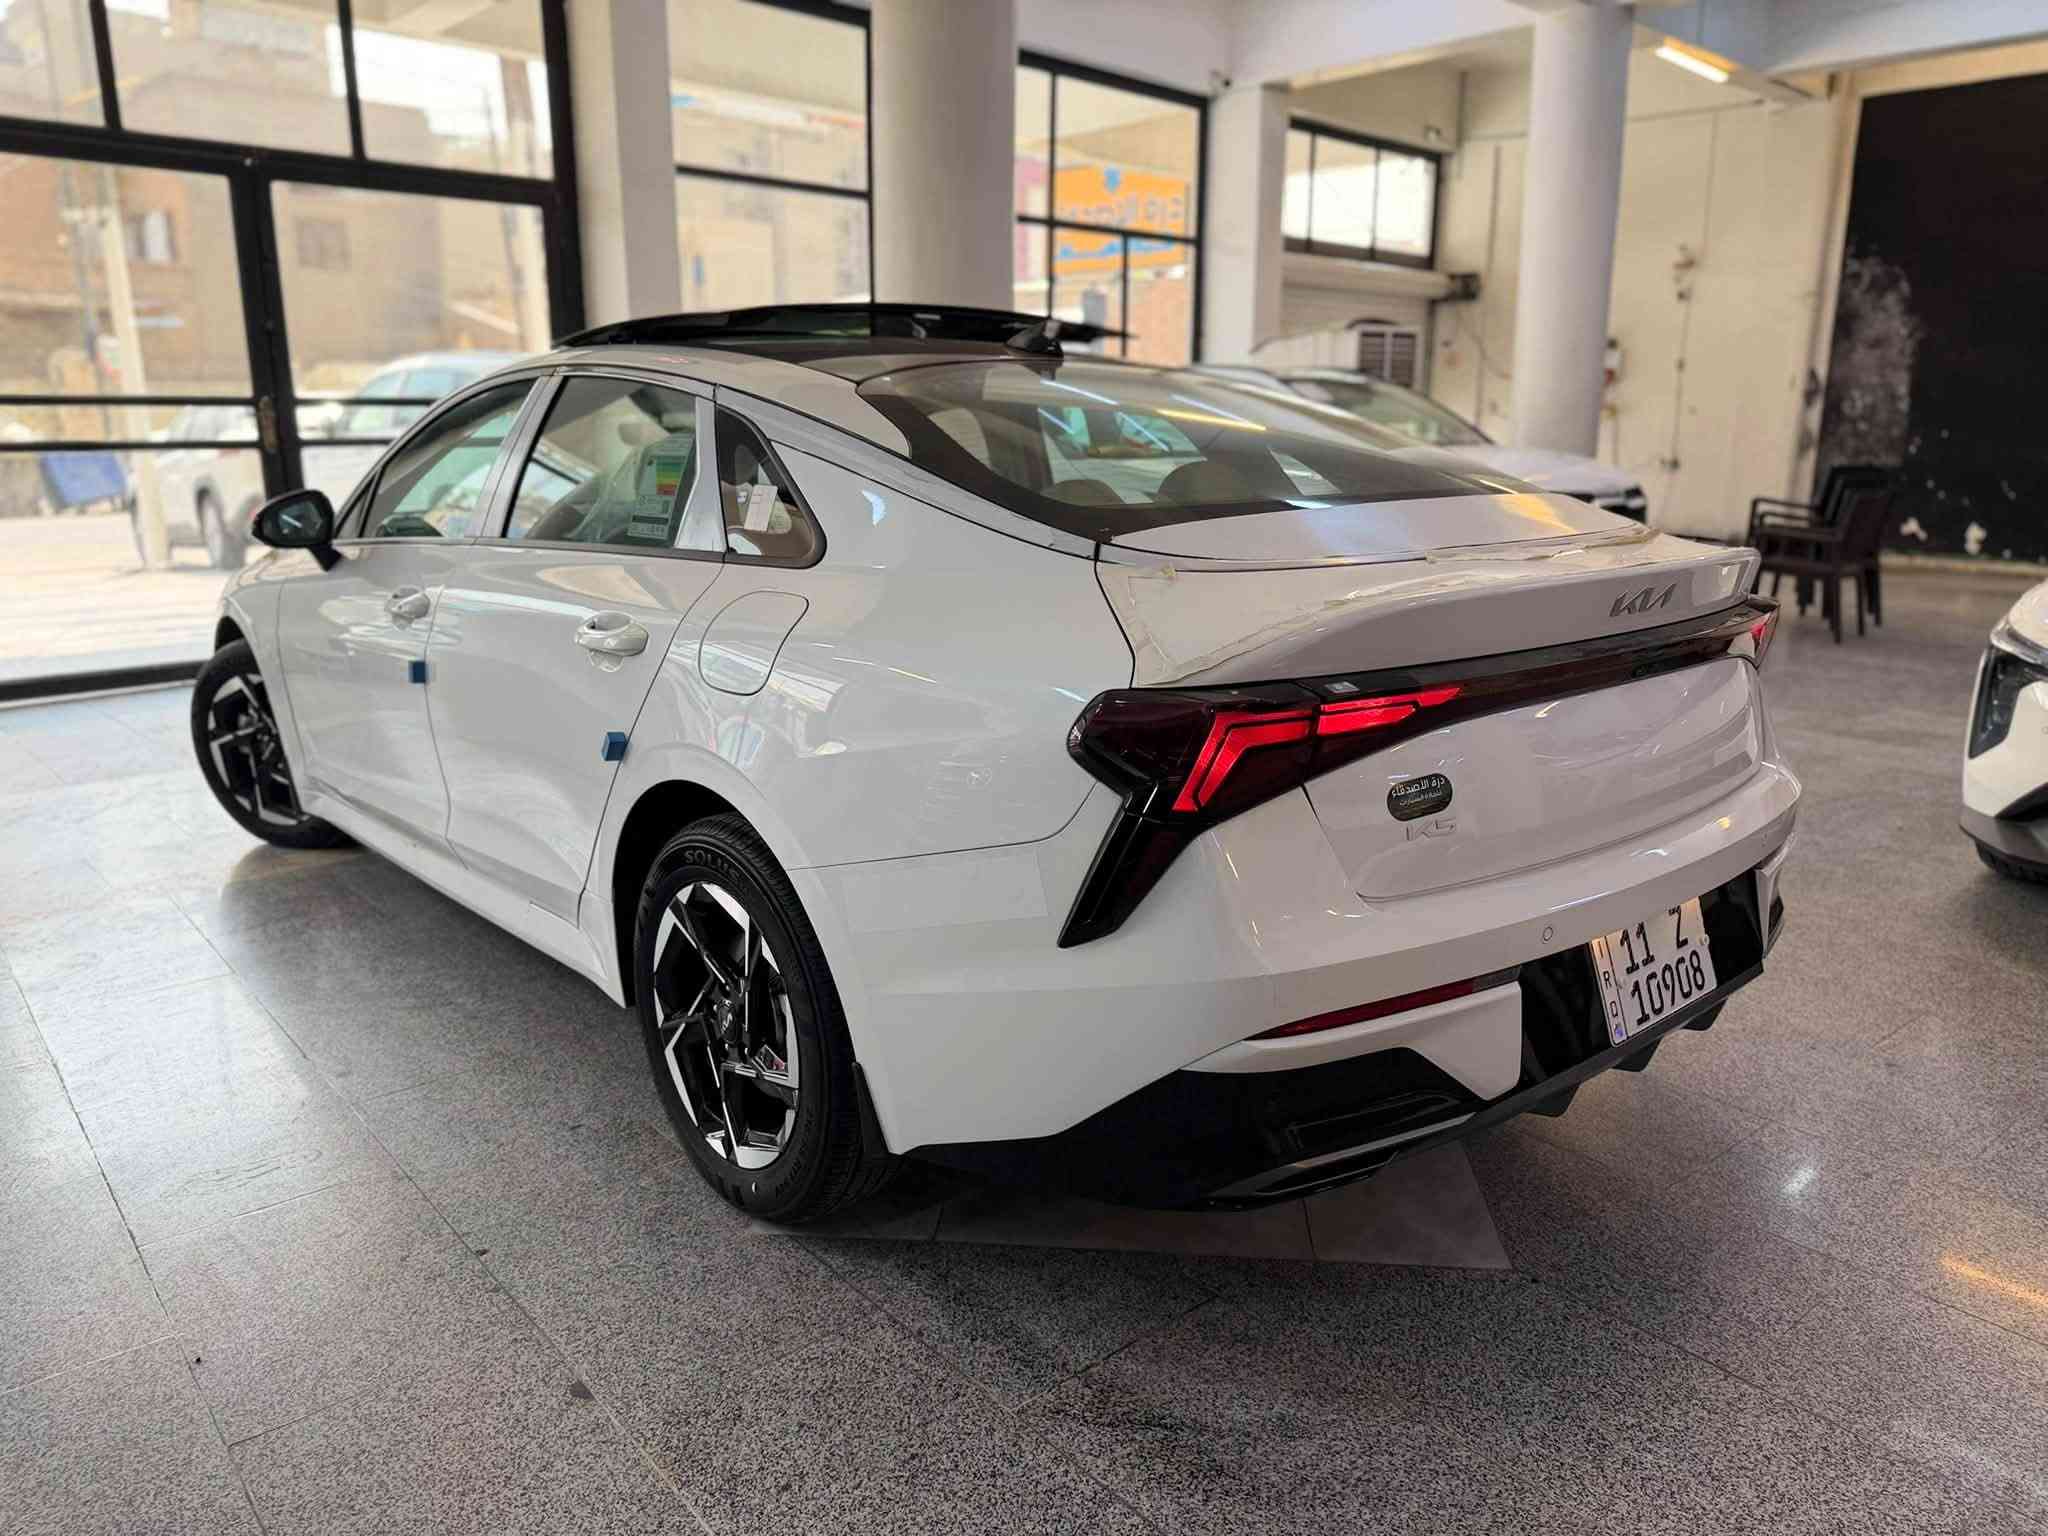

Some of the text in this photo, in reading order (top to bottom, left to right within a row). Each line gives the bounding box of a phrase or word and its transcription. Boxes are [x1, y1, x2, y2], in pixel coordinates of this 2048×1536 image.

[1609, 583, 1677, 617] KIA
[1406, 818, 1456, 841] K5
[684, 849, 742, 881] SOLUS
[1620, 905, 1689, 975] 11 Z
[1631, 949, 1706, 1026] 10908
